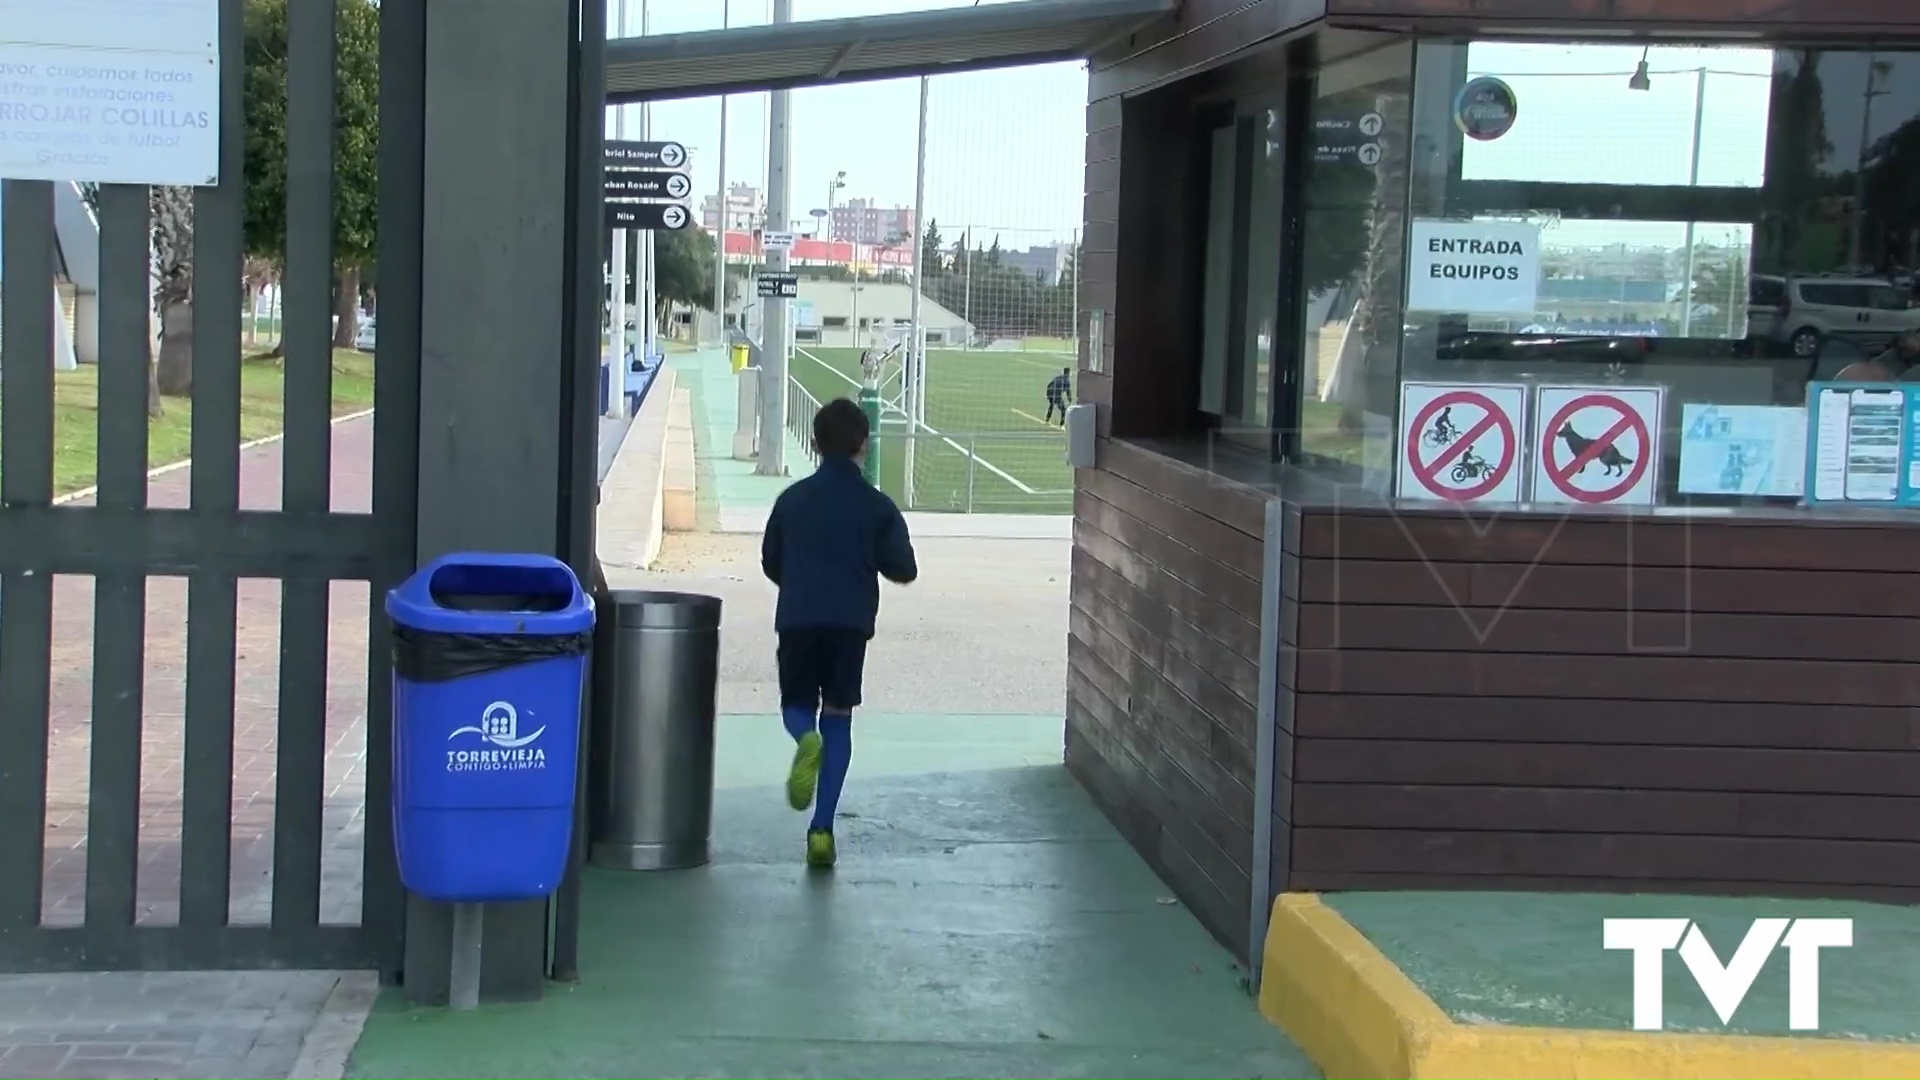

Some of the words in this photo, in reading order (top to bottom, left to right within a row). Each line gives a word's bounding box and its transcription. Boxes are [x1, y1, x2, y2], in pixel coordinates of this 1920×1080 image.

[144, 67, 194, 84] todos
[102, 106, 209, 129] COLILLAS
[1428, 237, 1524, 255] ENTRADA
[1430, 263, 1519, 280] EQUIPOS
[446, 748, 546, 763] TORREVIEJA
